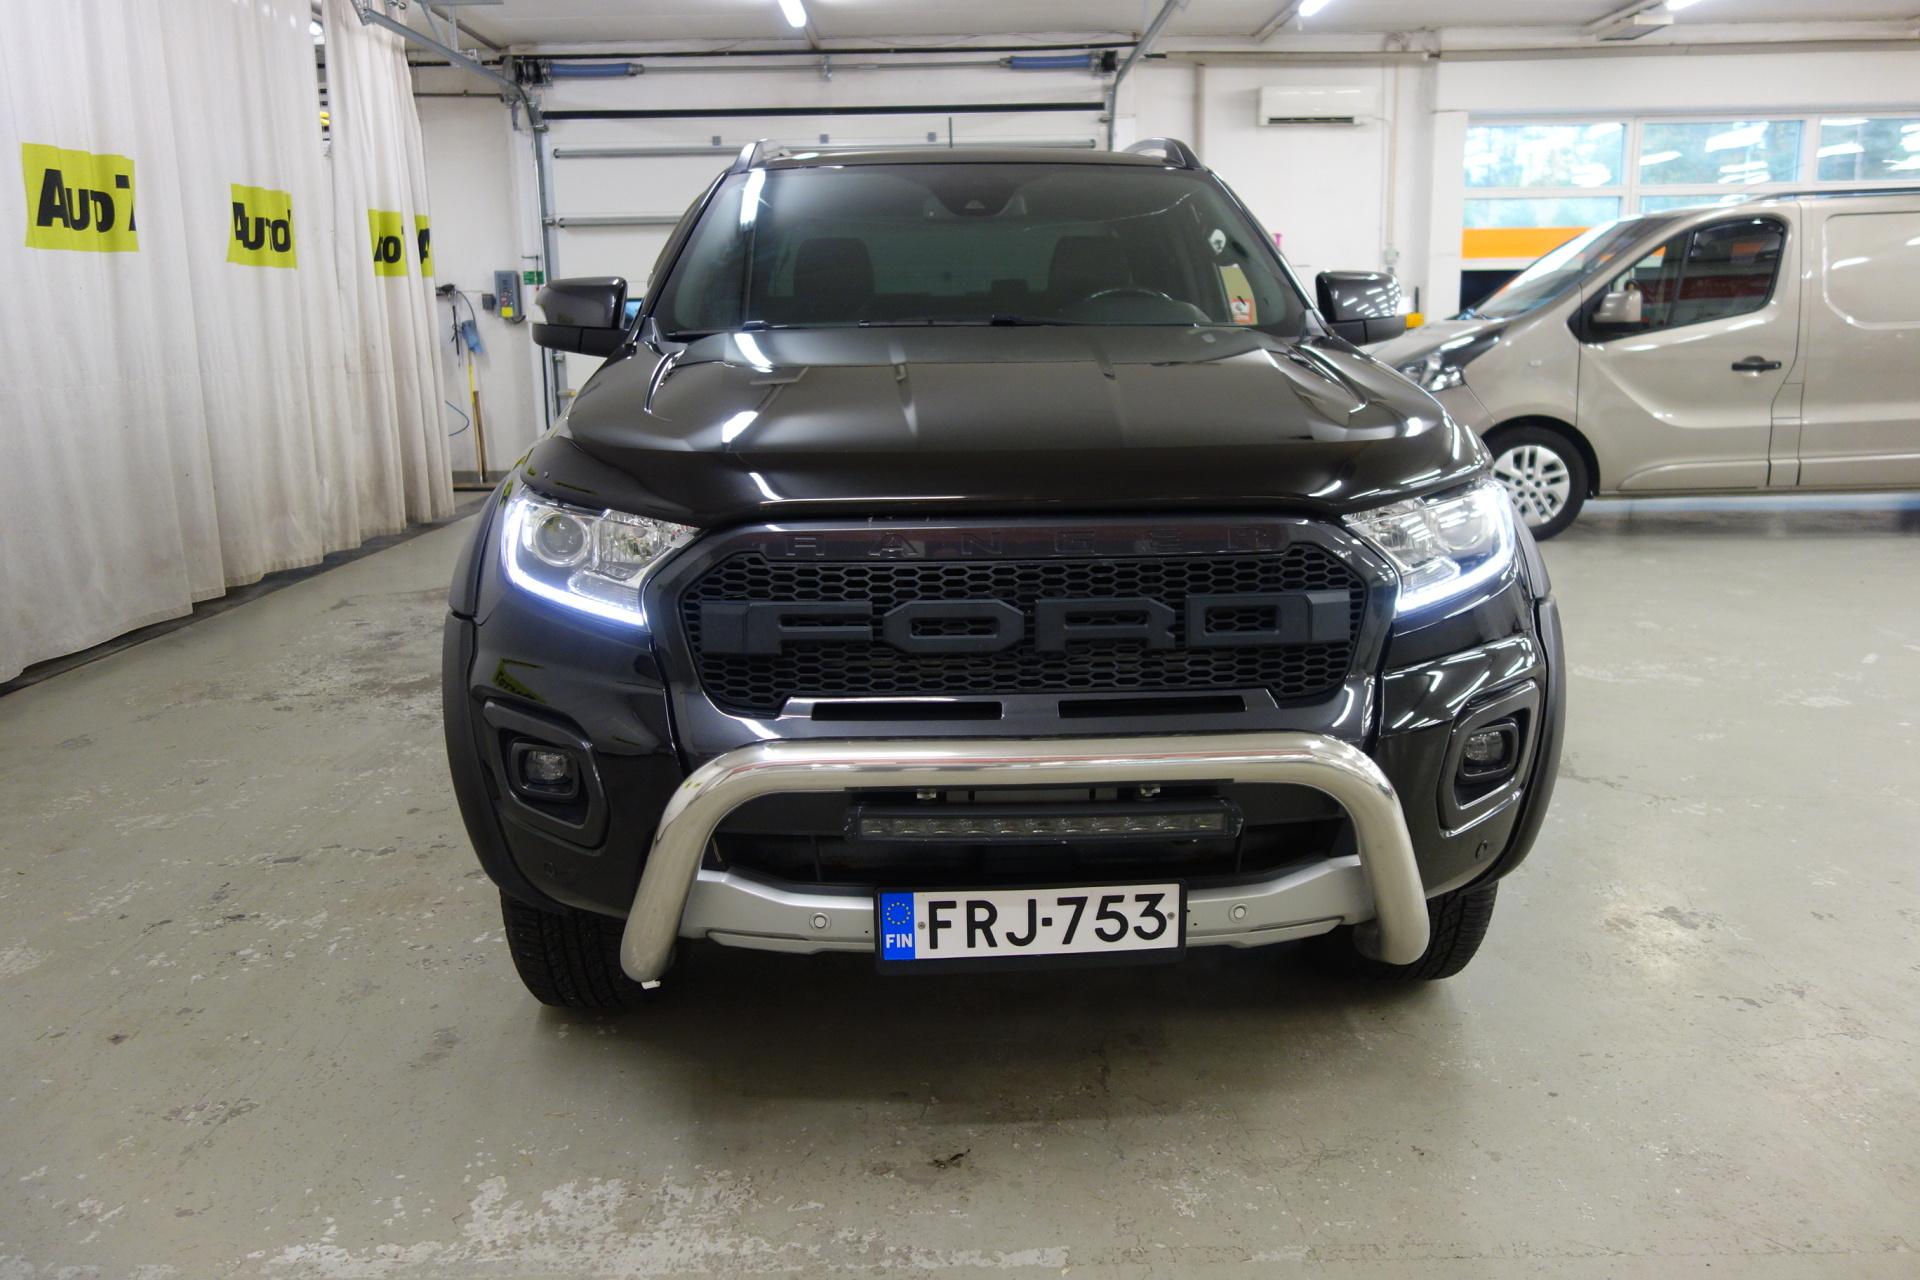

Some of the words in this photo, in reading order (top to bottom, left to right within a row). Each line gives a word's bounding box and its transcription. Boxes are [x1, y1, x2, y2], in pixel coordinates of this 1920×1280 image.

[784, 525, 1276, 557] RANGER
[702, 590, 1350, 654] FORD
[885, 933, 913, 949] FIN
[927, 893, 1168, 950] FRJ-753
